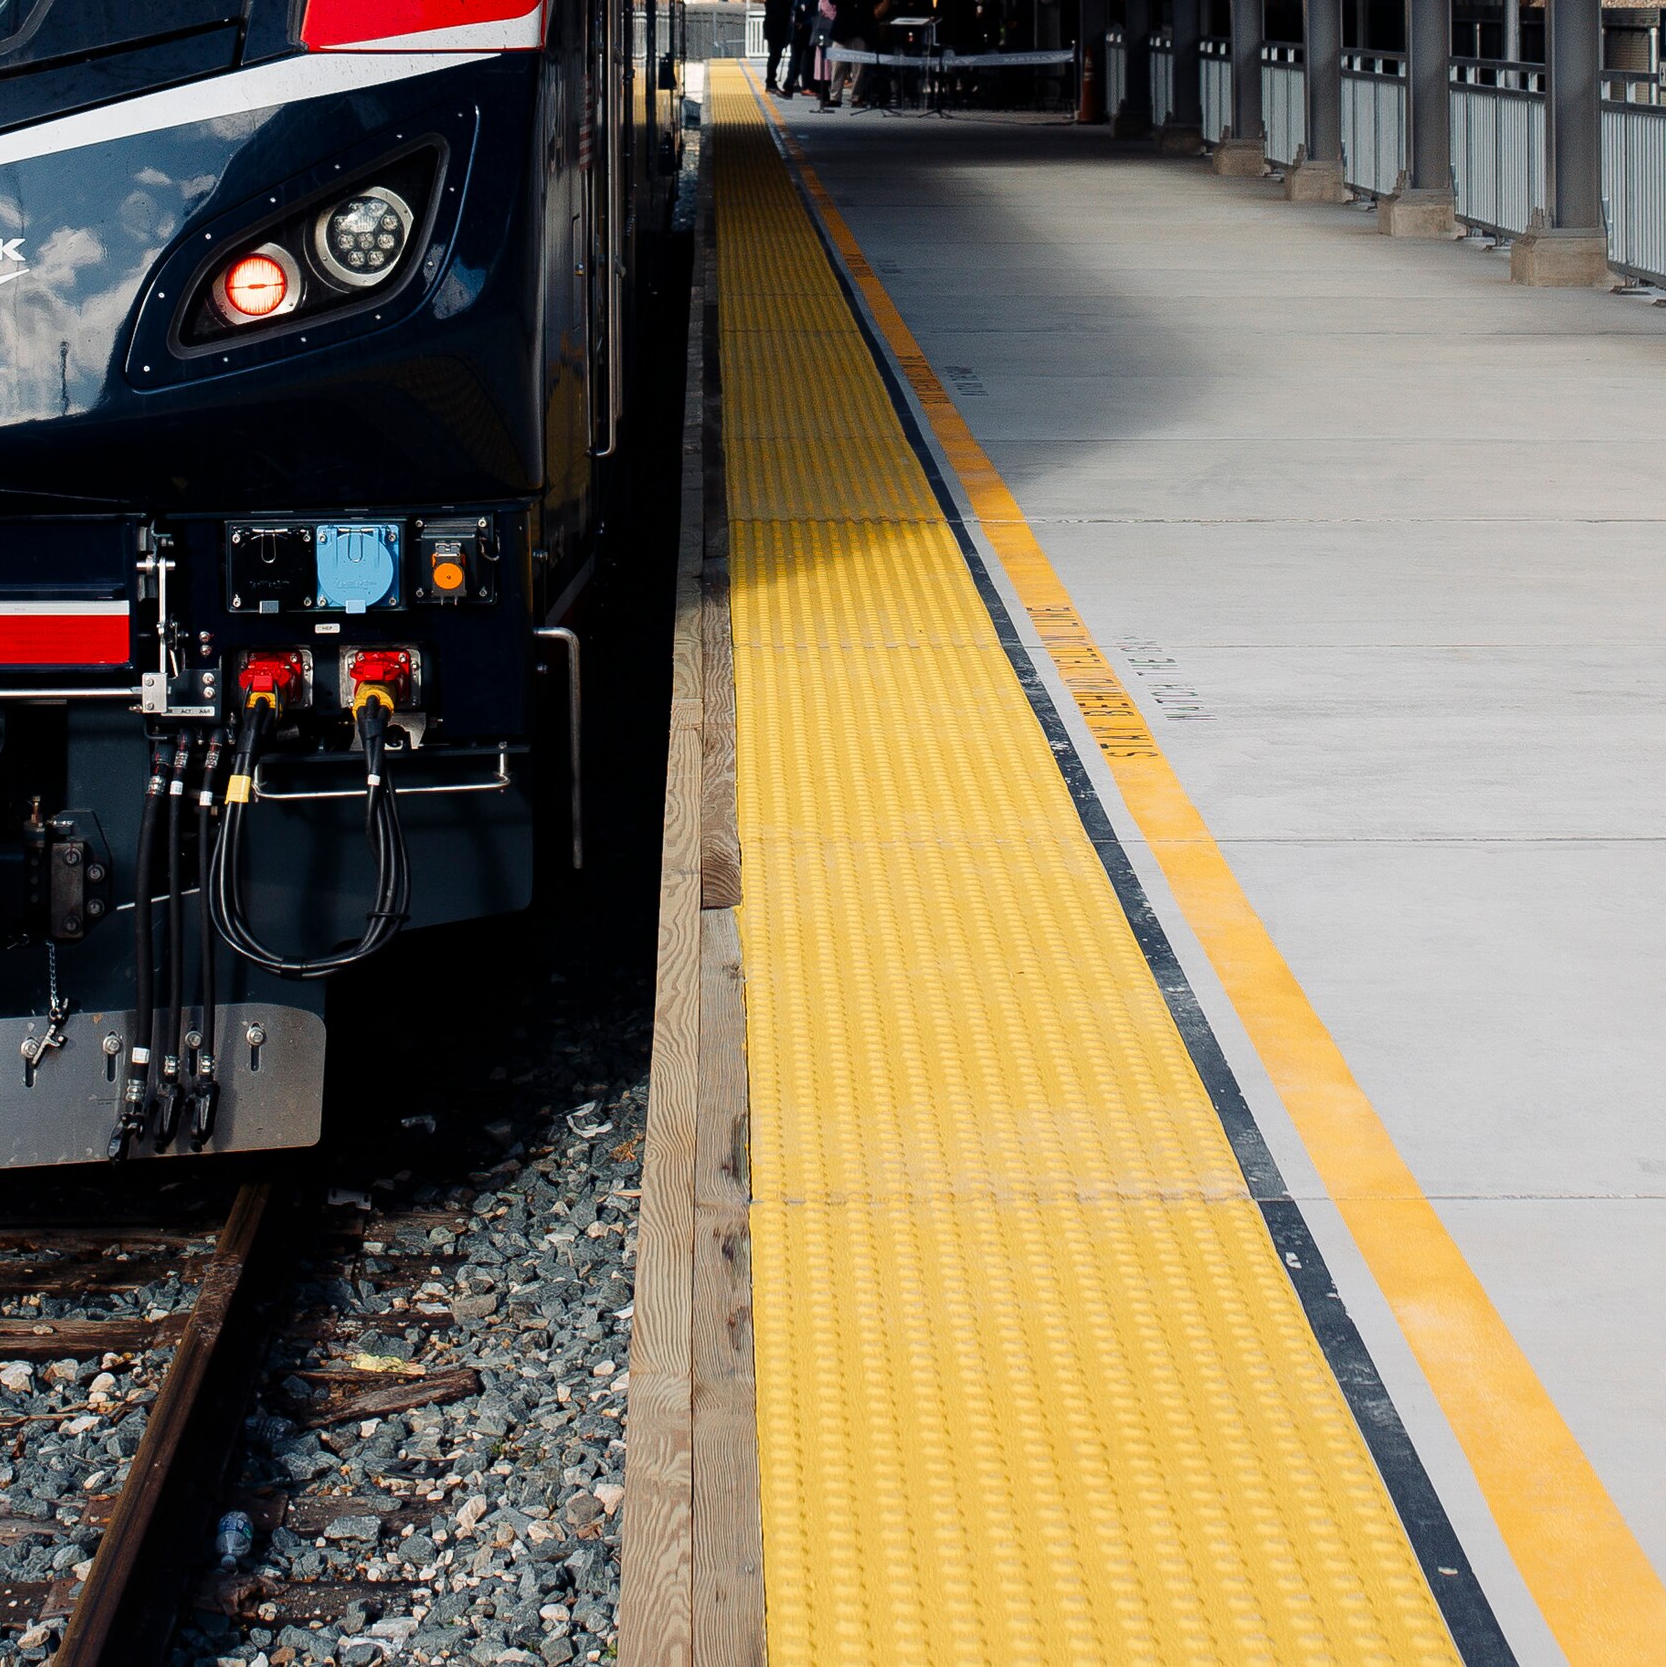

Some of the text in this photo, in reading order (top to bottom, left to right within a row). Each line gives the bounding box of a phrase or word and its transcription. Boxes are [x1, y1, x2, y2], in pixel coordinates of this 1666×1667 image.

[1026, 606, 1159, 759] STAY BEHIND YELLOW LINE
[1127, 658, 1182, 676] THE
